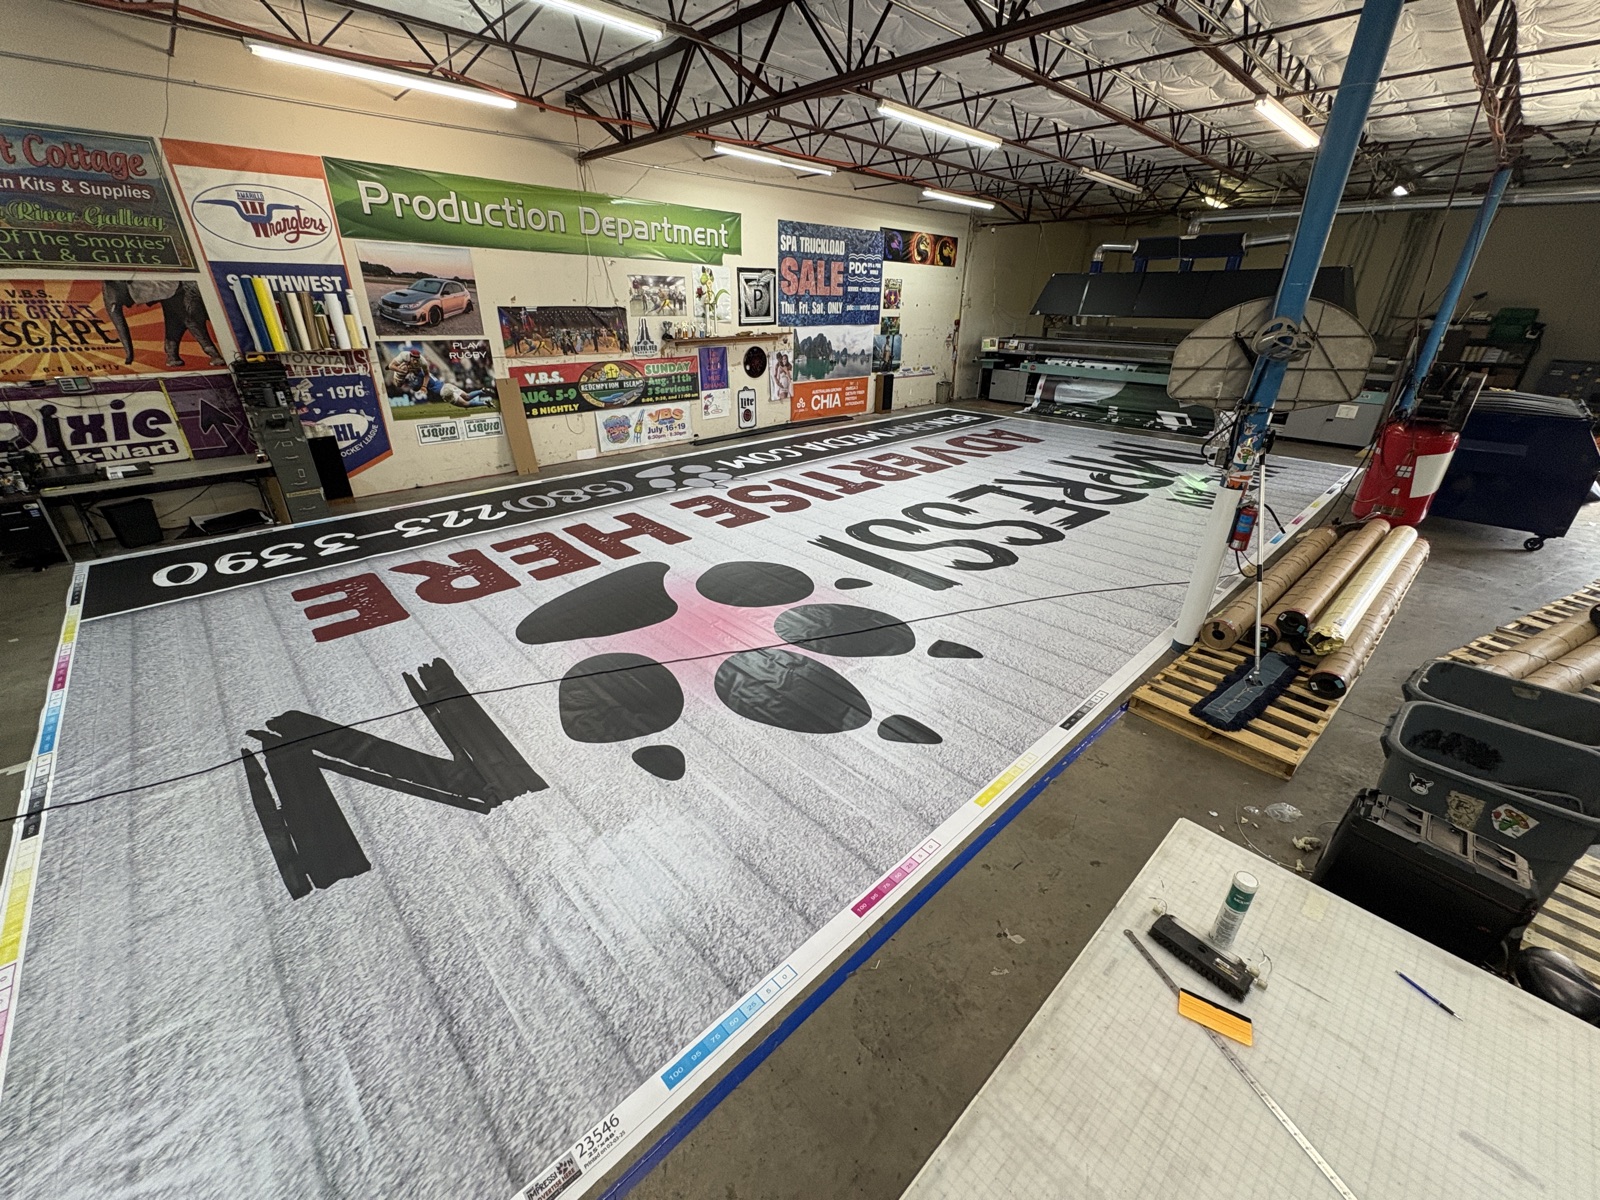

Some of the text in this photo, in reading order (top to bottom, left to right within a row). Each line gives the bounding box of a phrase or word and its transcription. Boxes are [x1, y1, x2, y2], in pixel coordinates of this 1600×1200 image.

[22, 133, 147, 181] Cottage
[20, 176, 56, 192] Kits
[61, 180, 74, 193] &
[79, 181, 151, 200] Supplies
[8, 201, 79, 223] River
[84, 206, 166, 232] Gallery
[356, 180, 729, 248] Production Department
[243, 203, 328, 244] Wranglers
[22, 229, 69, 247] The
[74, 233, 170, 250] Smokies"
[780, 234, 846, 255] SPA TRUCKLOAD
[60, 248, 76, 262] &
[92, 249, 162, 264] Gifts
[780, 256, 844, 296] SALE
[849, 262, 867, 274] PDC
[226, 274, 343, 292] STHWEST
[5, 289, 52, 299] V.B.S.
[754, 289, 763, 309] P
[26, 305, 99, 320] GREAT
[781, 302, 797, 315] Thu,
[827, 302, 843, 315] ONLY
[0, 319, 122, 347] SCAPE
[453, 341, 480, 350] PLAY
[283, 354, 345, 366] TOYOTA
[449, 351, 487, 360] RUGBY
[644, 361, 691, 376] SUNDAY
[524, 371, 564, 385] V.B.S.
[581, 380, 644, 391] REDEMPTION ISLAND
[327, 385, 365, 399] 1976
[521, 388, 577, 405] AUG. 5-9
[540, 404, 580, 415] NIGHTLY
[740, 398, 754, 409] Lite
[811, 393, 841, 411] CHIA
[647, 408, 684, 422] VBS
[0, 399, 173, 451] Dixie
[647, 426, 664, 434] July
[340, 443, 364, 458] OCKEY
[671, 428, 1044, 529] ADVERTISE
[291, 512, 692, 643] HERE
[856, 903, 867, 913] 100
[669, 1066, 684, 1081] 100
[710, 1033, 721, 1044] 75
[575, 1113, 620, 1159] 23546
[584, 1153, 600, 1169] Printed
[562, 1168, 575, 1182] HERE
